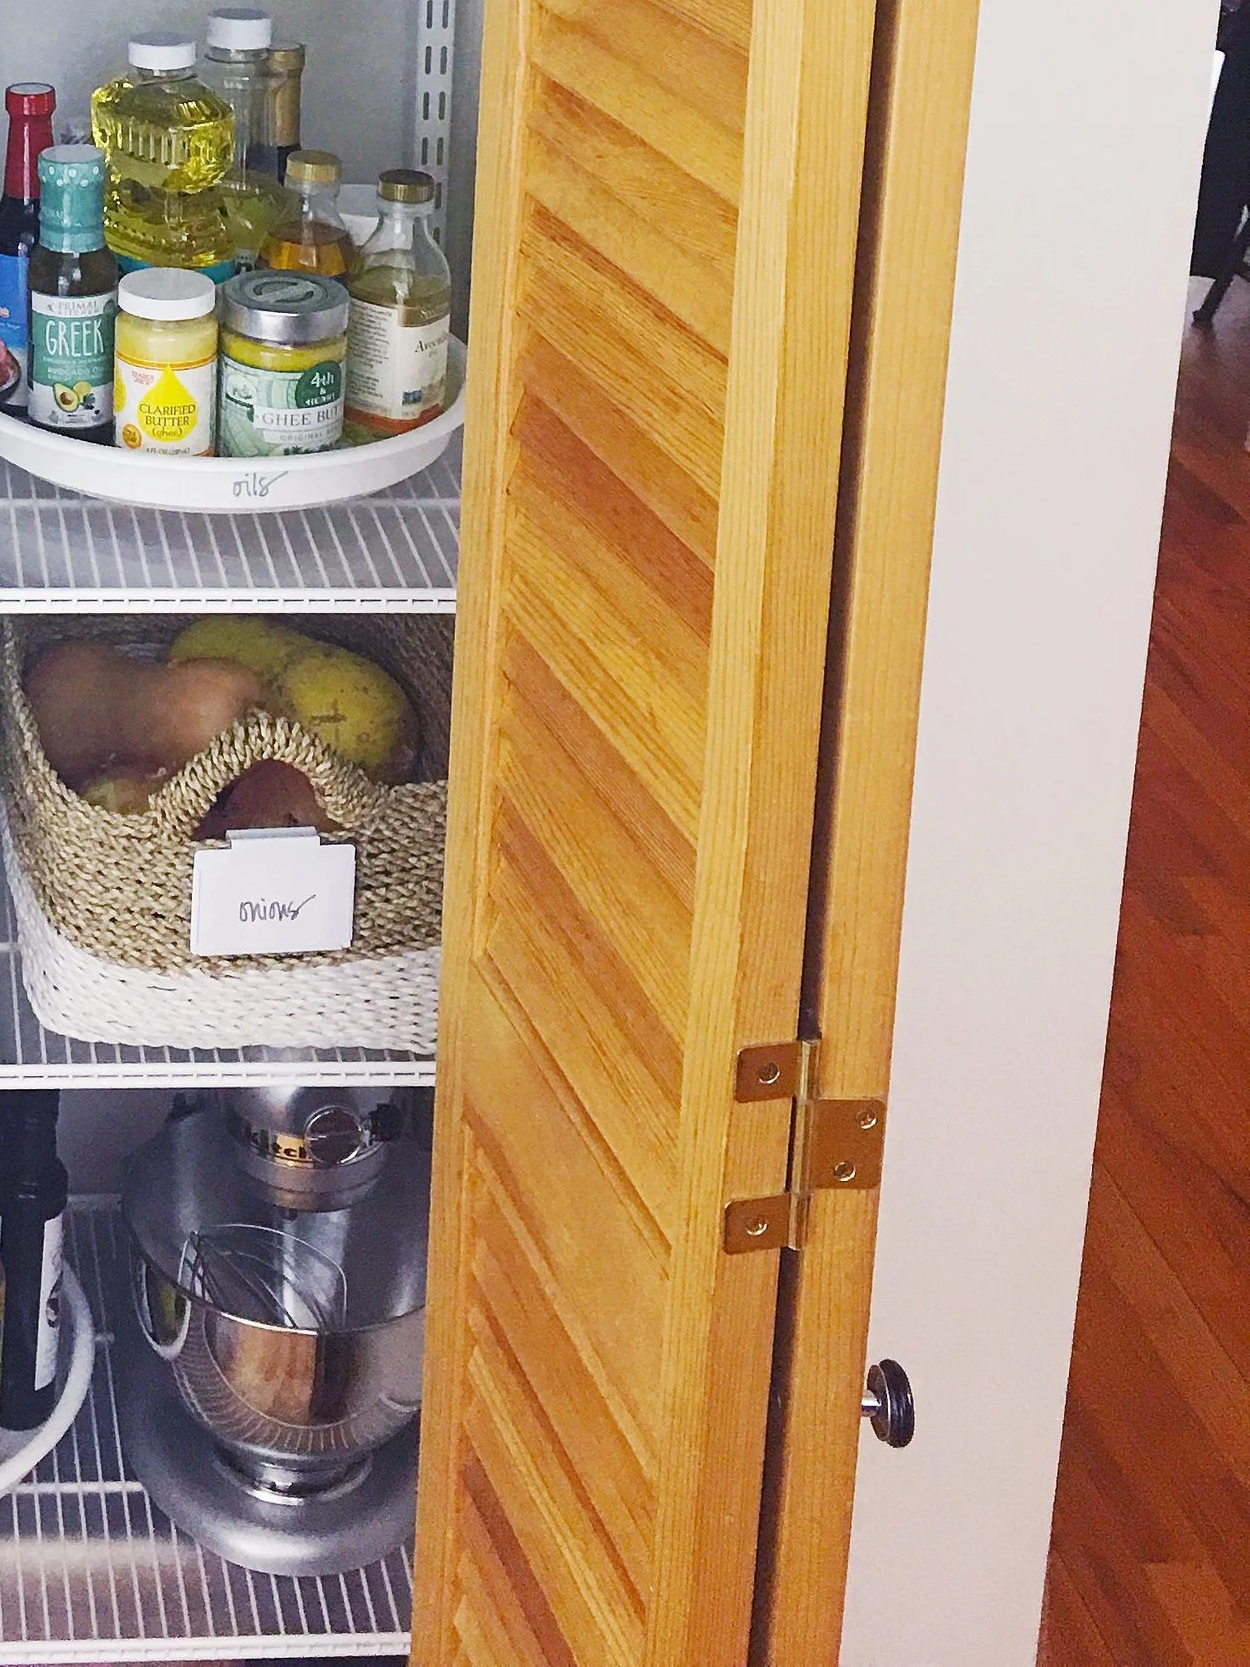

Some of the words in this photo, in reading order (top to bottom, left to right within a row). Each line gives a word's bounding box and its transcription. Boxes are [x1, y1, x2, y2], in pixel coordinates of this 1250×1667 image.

[58, 300, 100, 313] PRIMAL
[45, 318, 104, 357] GREEK
[310, 371, 335, 388] 4th
[139, 403, 196, 416] CLARIFIED
[145, 416, 190, 427] BUTTER
[261, 412, 311, 427] GHEE
[232, 470, 290, 498] oils
[239, 894, 317, 922] onions
